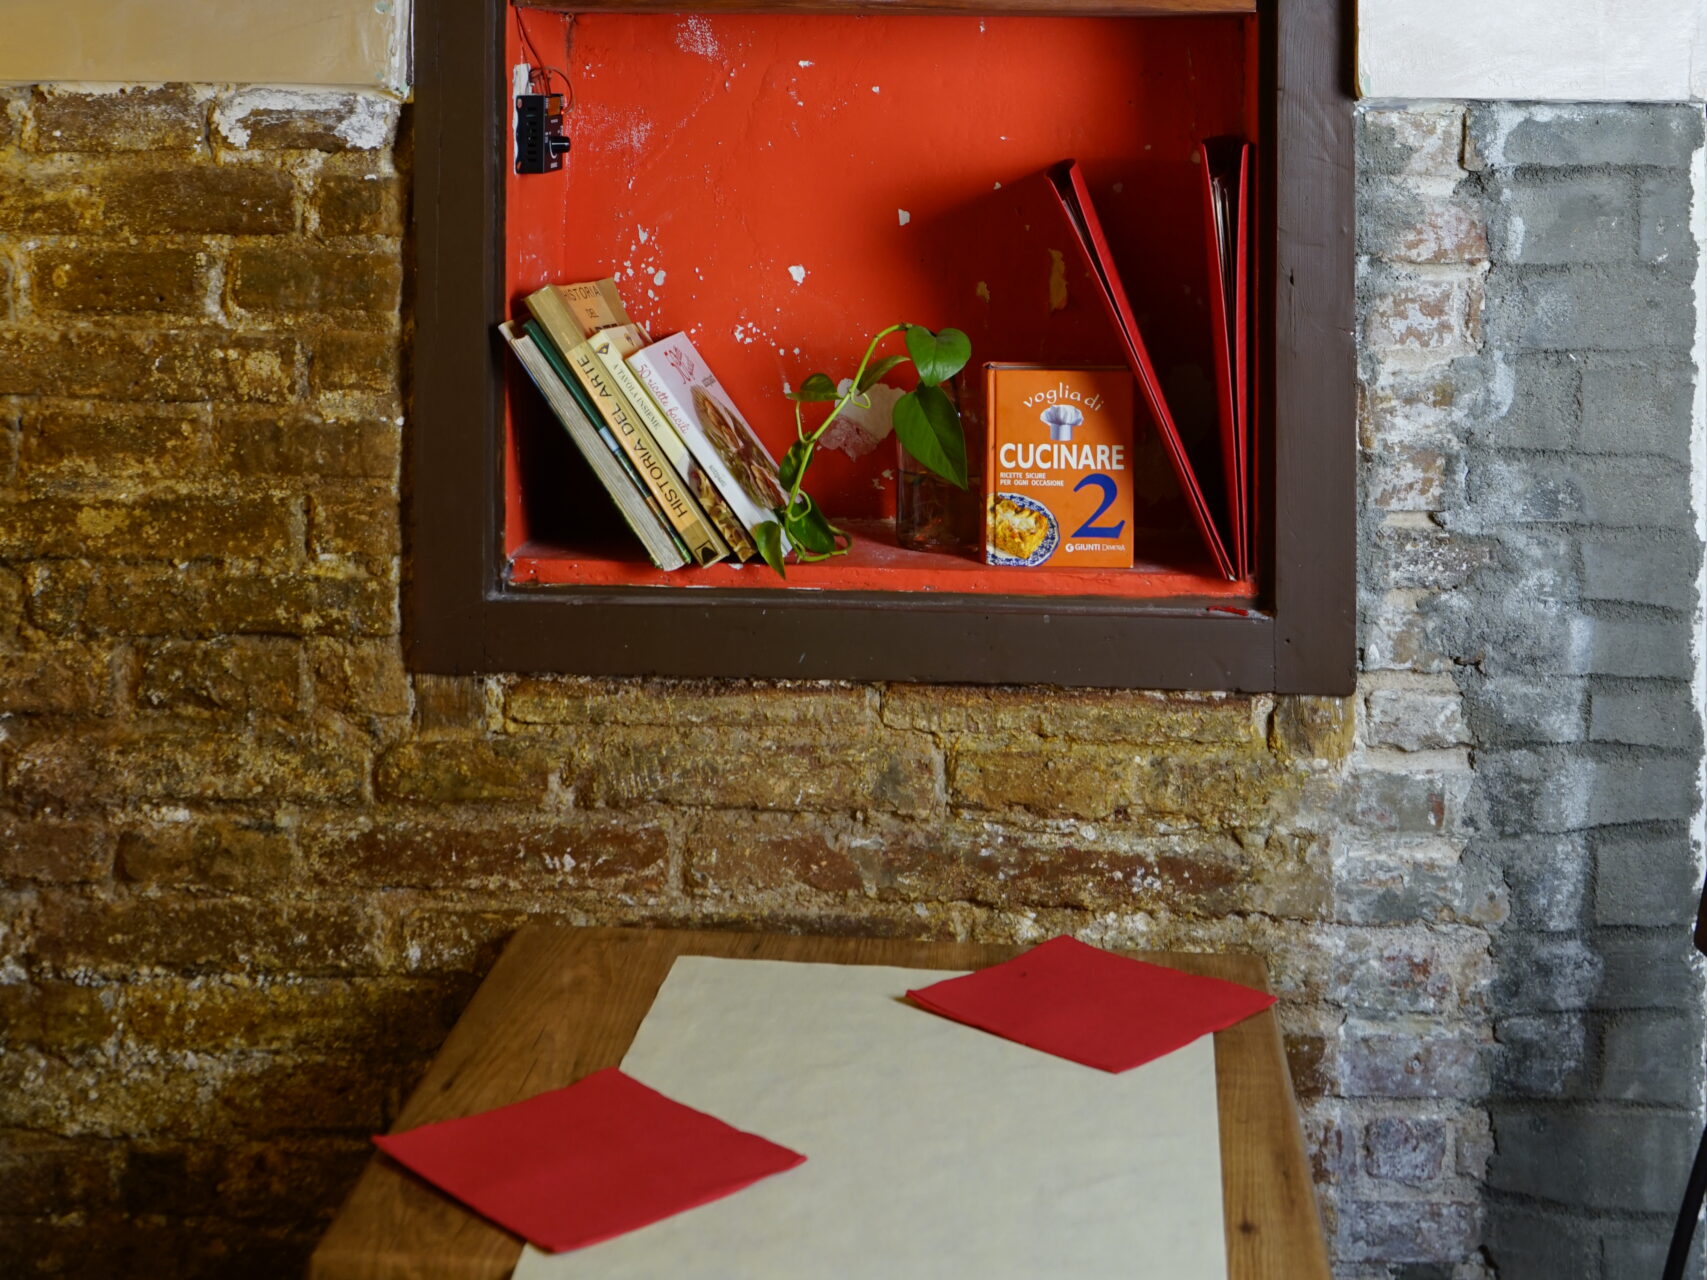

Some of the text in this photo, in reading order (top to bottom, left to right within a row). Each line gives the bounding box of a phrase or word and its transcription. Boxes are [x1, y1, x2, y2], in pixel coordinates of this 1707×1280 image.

[576, 355, 612, 399] ARTE
[638, 363, 652, 379] 50
[1023, 381, 1105, 412] voglia di
[611, 402, 635, 437] DEL
[1000, 442, 1125, 470] CUCINARE
[633, 438, 688, 518] HISTORIA
[1031, 479, 1065, 487] OCCASIONE
[1071, 472, 1126, 539] 2
[1075, 543, 1101, 552] GIUNTI
